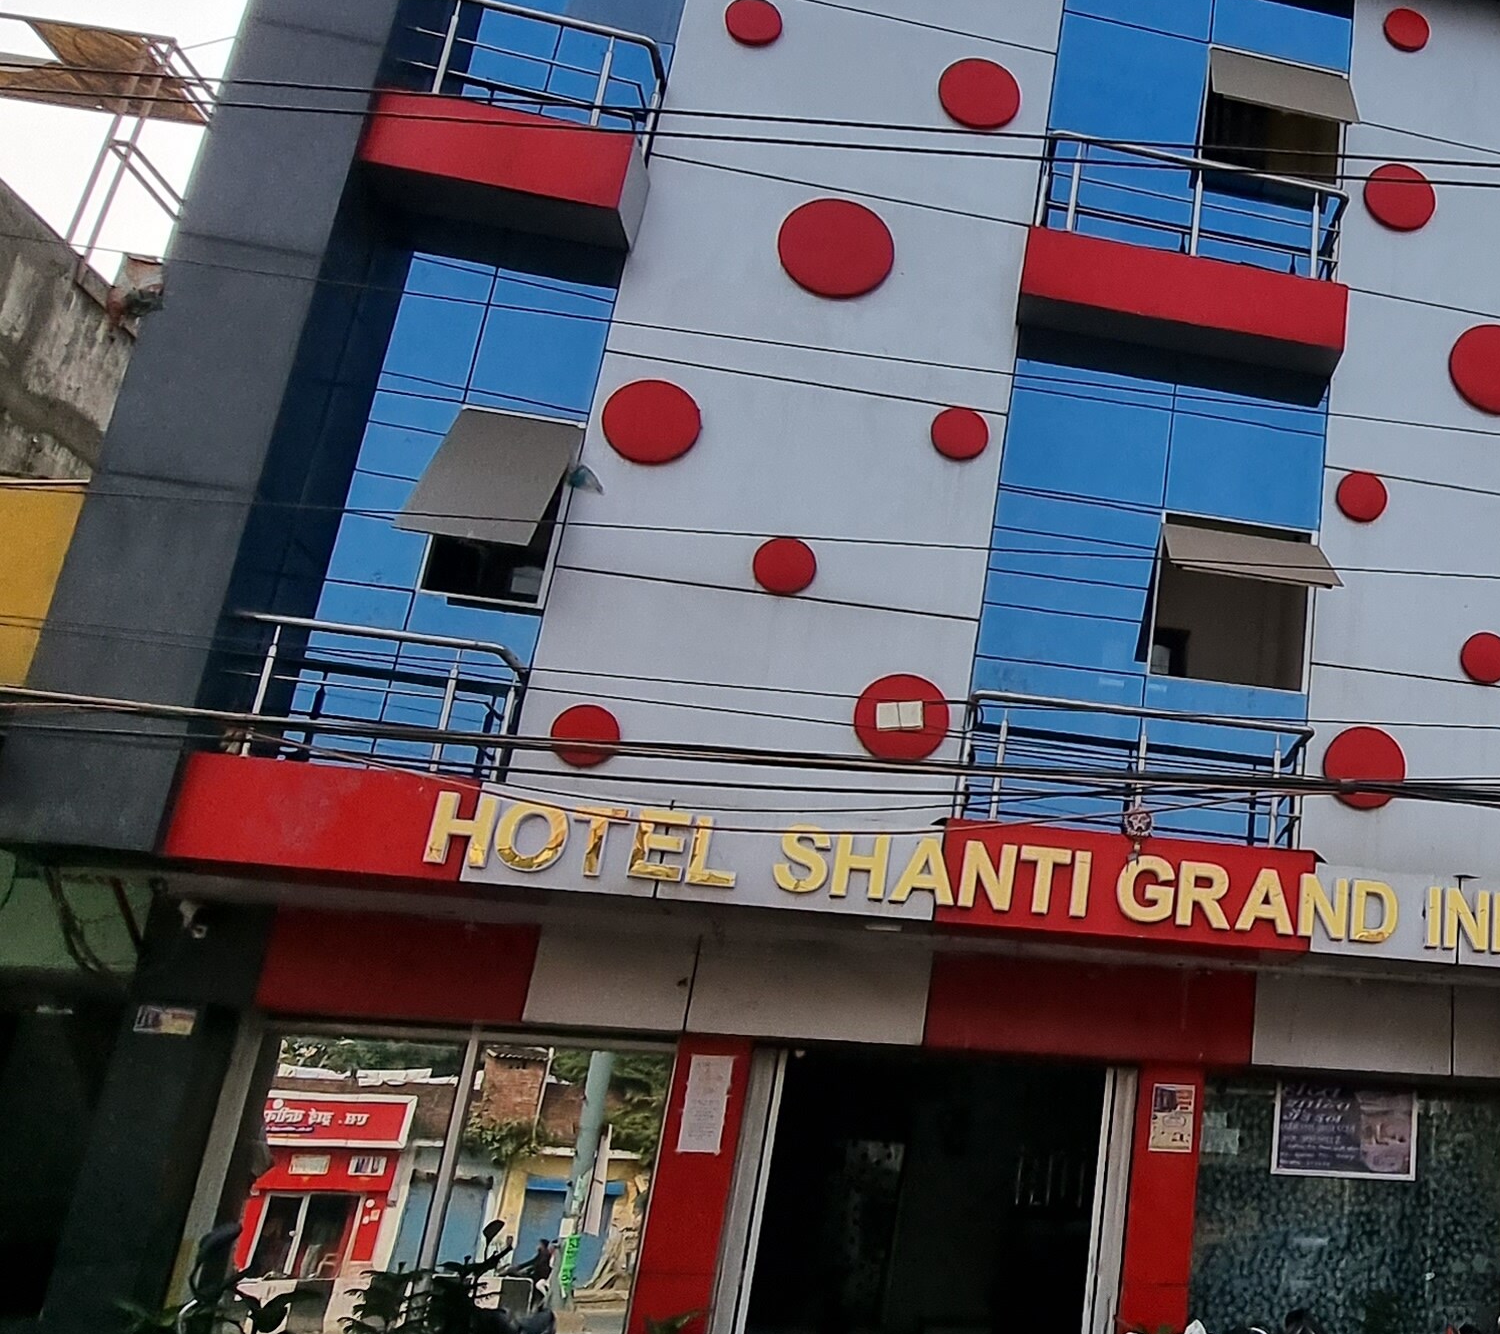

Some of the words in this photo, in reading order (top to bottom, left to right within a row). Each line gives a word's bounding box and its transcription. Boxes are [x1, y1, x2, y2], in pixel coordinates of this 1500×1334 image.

[422, 790, 738, 888] HOTEL
[772, 823, 1092, 918] SHANTI
[1117, 855, 1400, 944] GRAND
